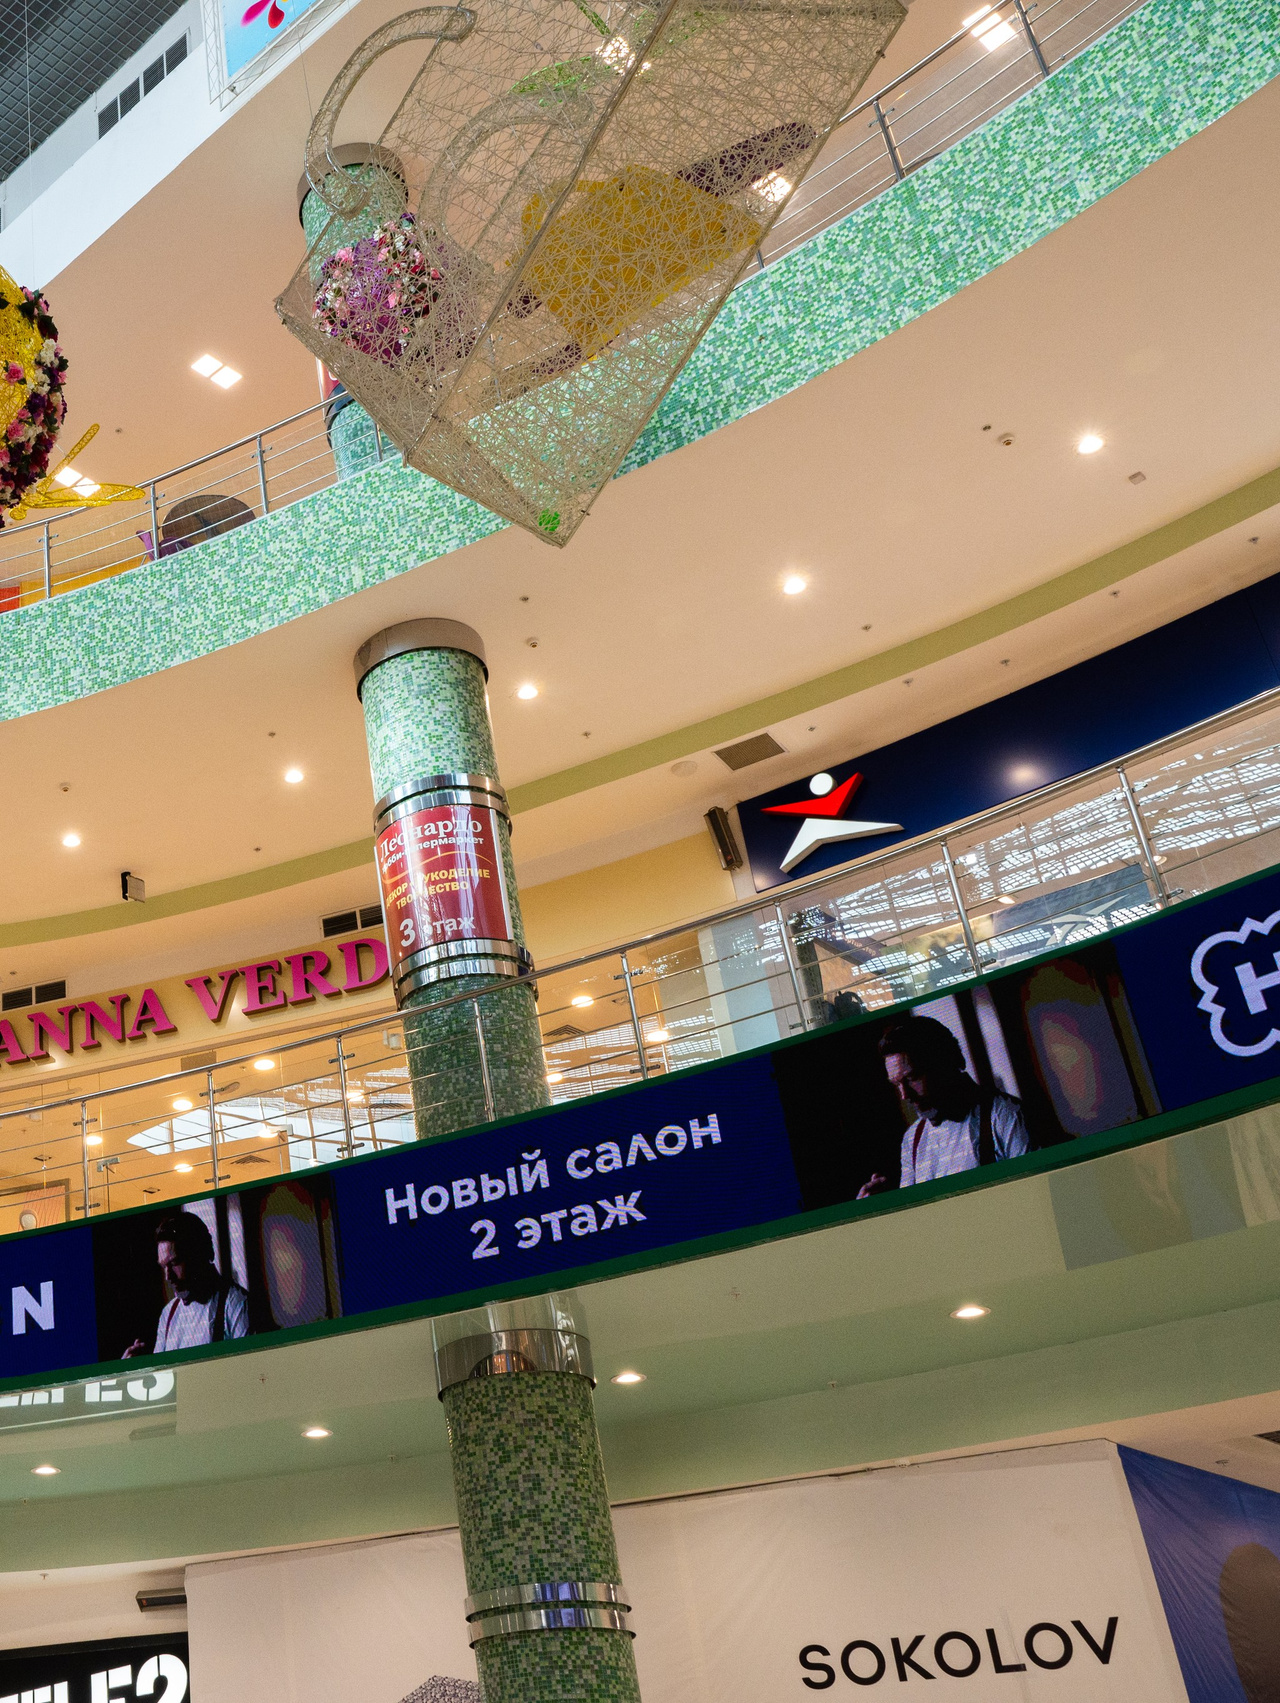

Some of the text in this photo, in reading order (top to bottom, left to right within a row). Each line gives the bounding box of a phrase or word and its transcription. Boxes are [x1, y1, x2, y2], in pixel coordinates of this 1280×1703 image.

[396, 881, 469, 910] ТВОЕСТВО
[419, 868, 491, 886] УКОДЕЛИЕ
[400, 918, 416, 947] 3
[385, 1113, 722, 1225] Новый салон
[470, 1190, 647, 1260] 2 этаж
[799, 1616, 1118, 1690] SOKOLOV
